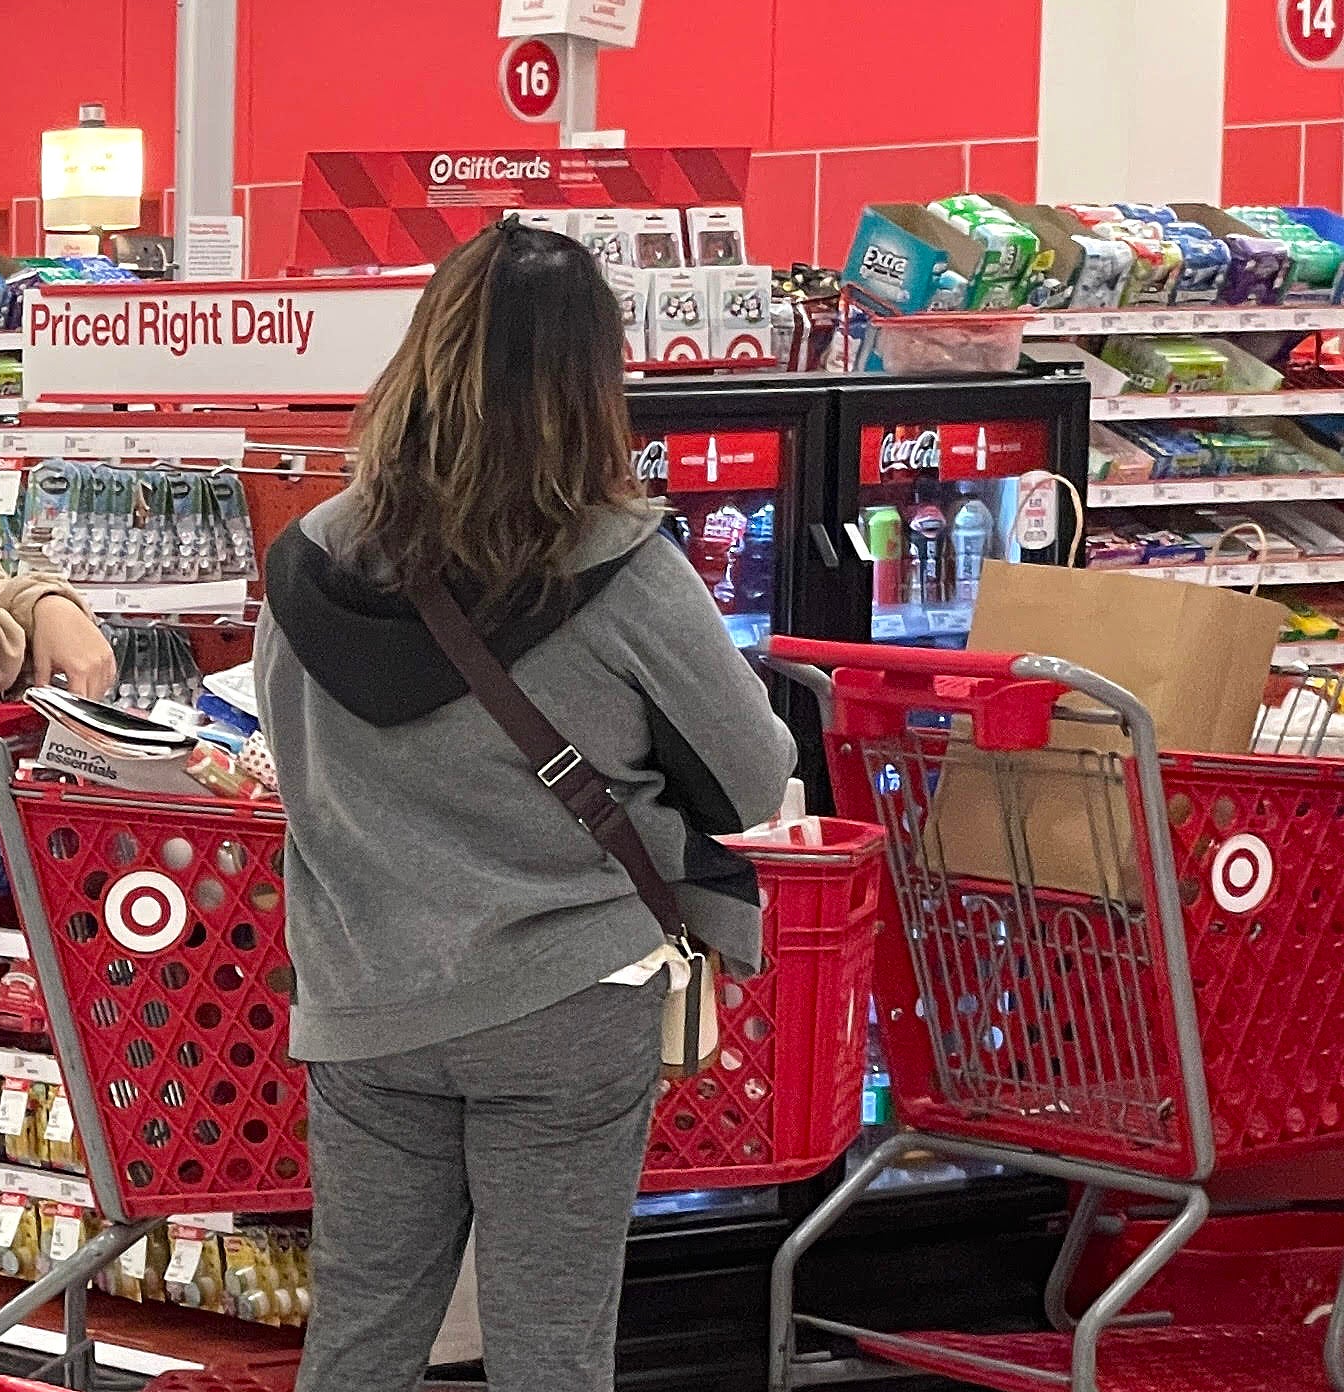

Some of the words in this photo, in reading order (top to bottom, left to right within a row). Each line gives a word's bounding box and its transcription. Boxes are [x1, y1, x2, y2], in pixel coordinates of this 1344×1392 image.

[1297, 0, 1336, 38] 14
[515, 60, 551, 97] 16
[454, 156, 551, 180] GiftCards
[29, 300, 130, 348] Priced
[138, 300, 222, 356] Right
[231, 298, 315, 356] Daily
[45, 750, 118, 782] essentials
[47, 740, 88, 761] room
